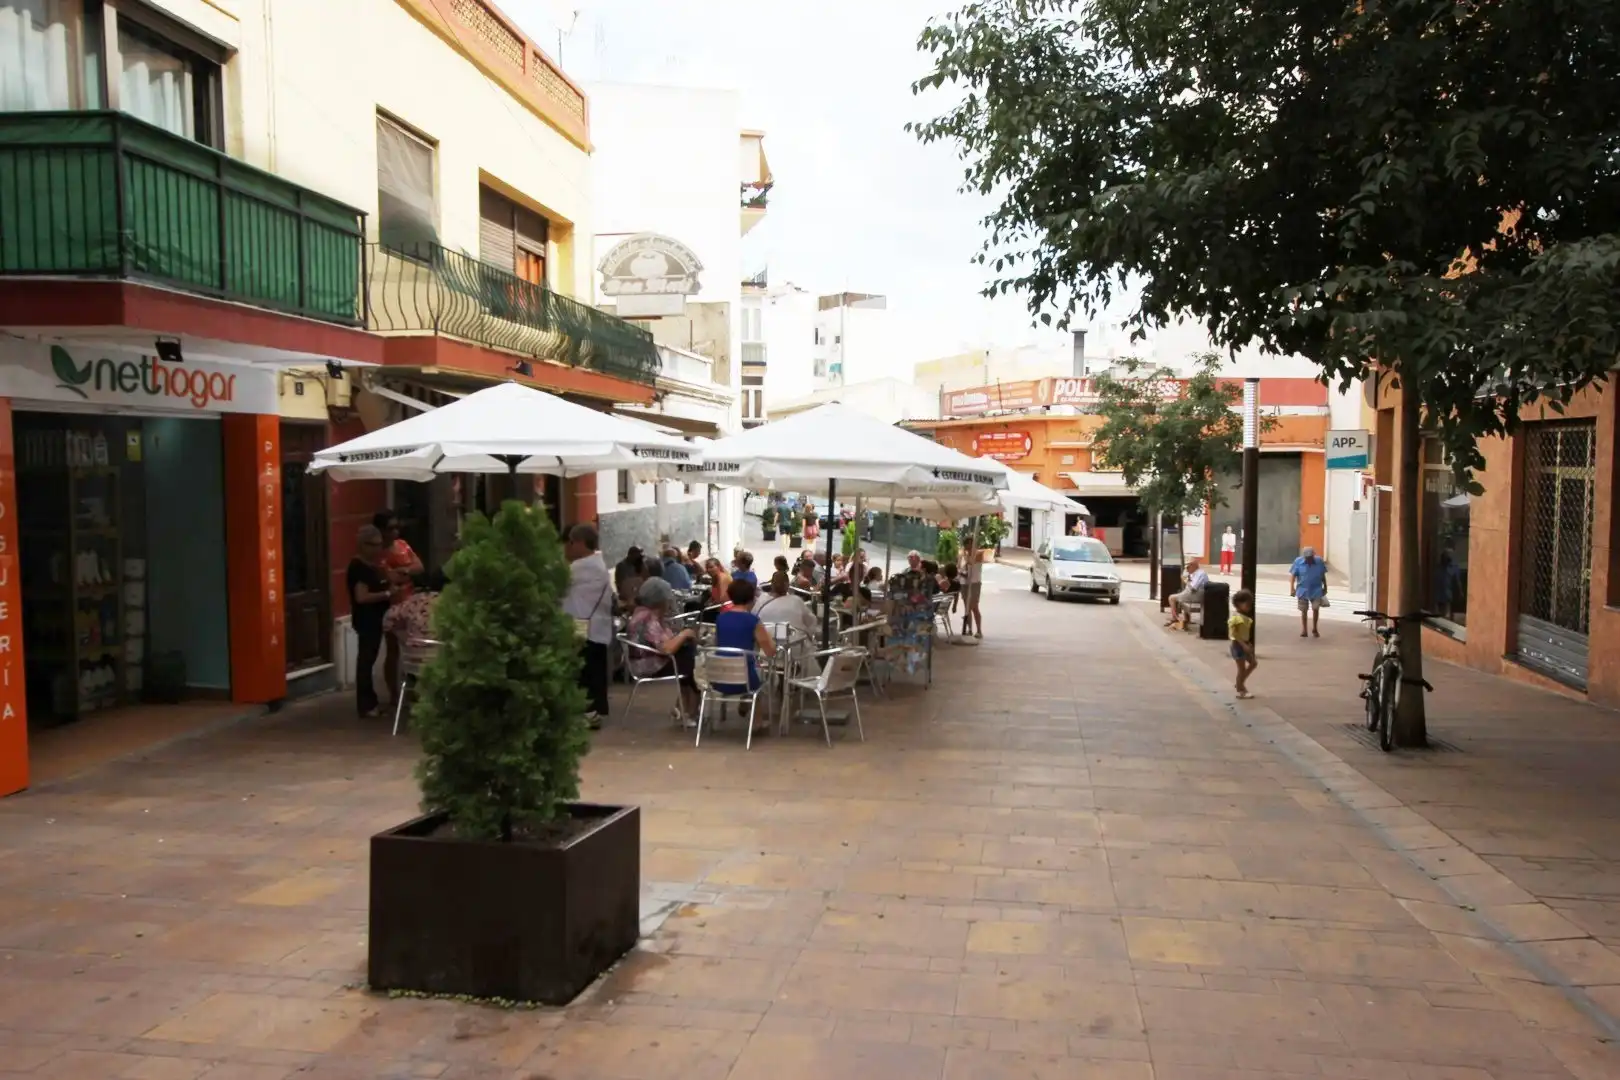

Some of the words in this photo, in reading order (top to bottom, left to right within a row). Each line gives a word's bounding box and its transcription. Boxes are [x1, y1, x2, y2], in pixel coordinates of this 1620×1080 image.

[95, 355, 236, 408] nethogar
[641, 448, 670, 459] ESTRELLA
[671, 450, 690, 460] DAMM
[685, 461, 716, 472] ESTRELLA
[718, 463, 740, 472] DAMM
[941, 471, 973, 482] ESTRELLA
[974, 474, 994, 485] DAMM
